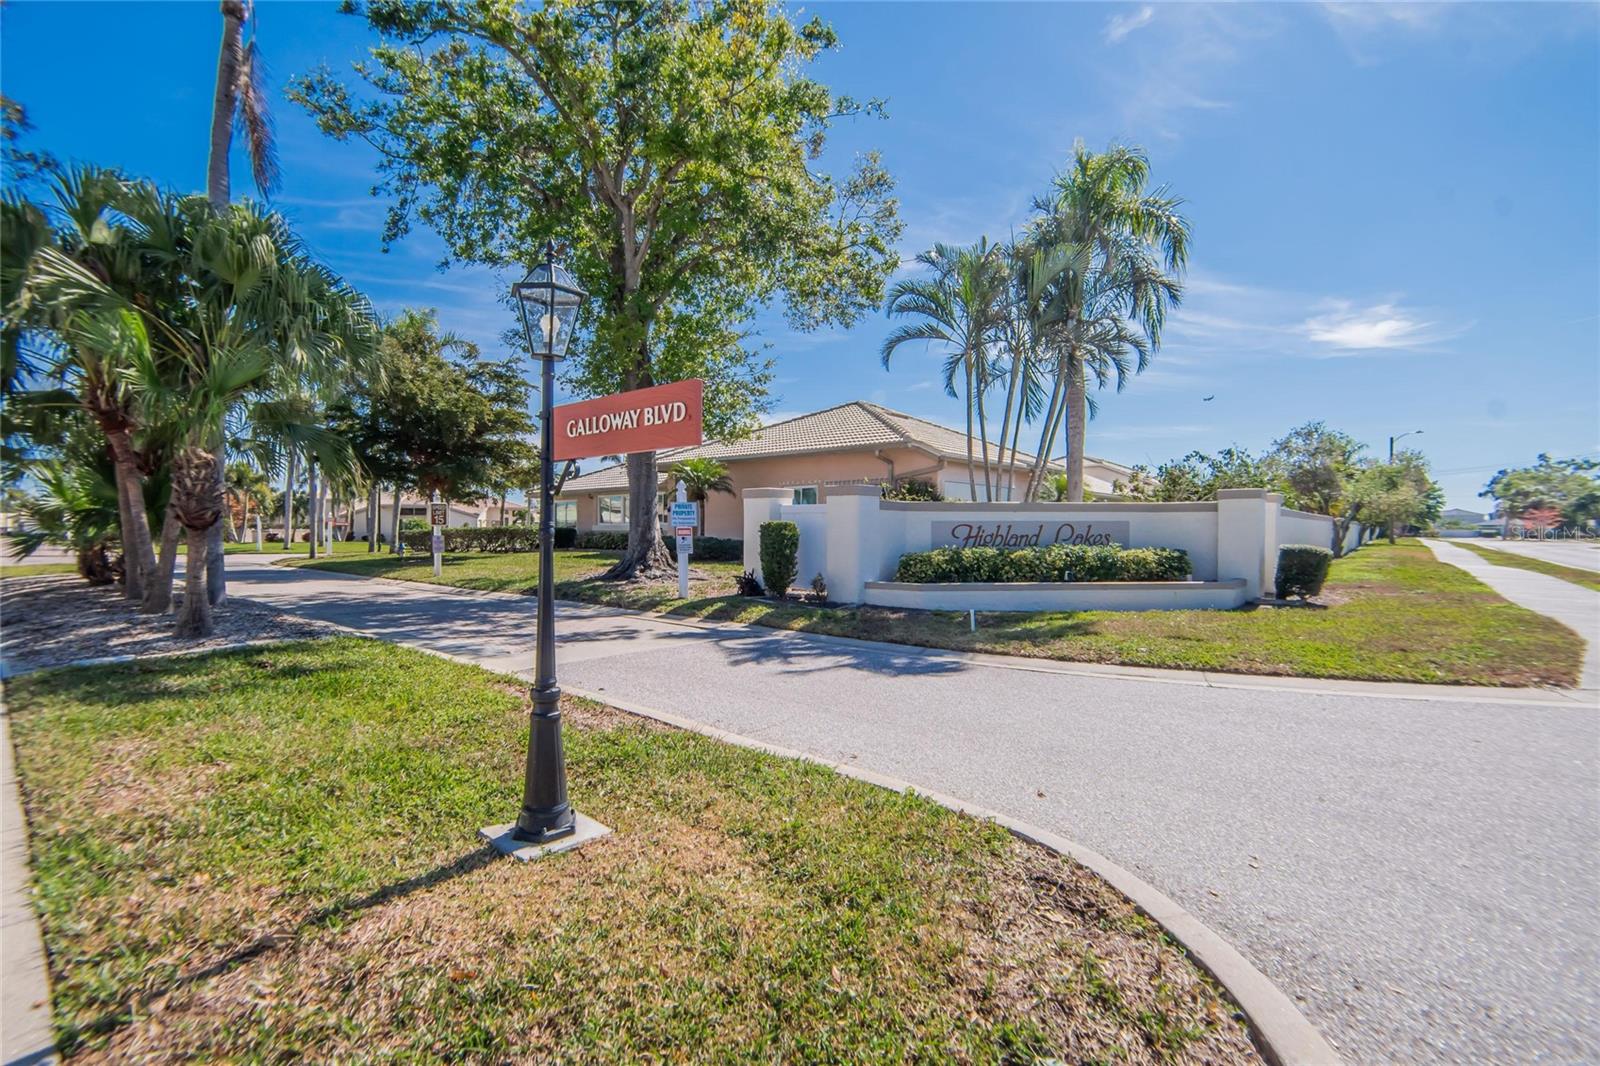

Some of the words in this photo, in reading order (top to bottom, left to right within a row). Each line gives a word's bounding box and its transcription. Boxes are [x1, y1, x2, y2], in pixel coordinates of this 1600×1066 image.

[566, 408, 641, 438] GALLOWAY
[643, 401, 688, 426] BLVD
[433, 515, 445, 525] 15
[951, 523, 1044, 548] Highland
